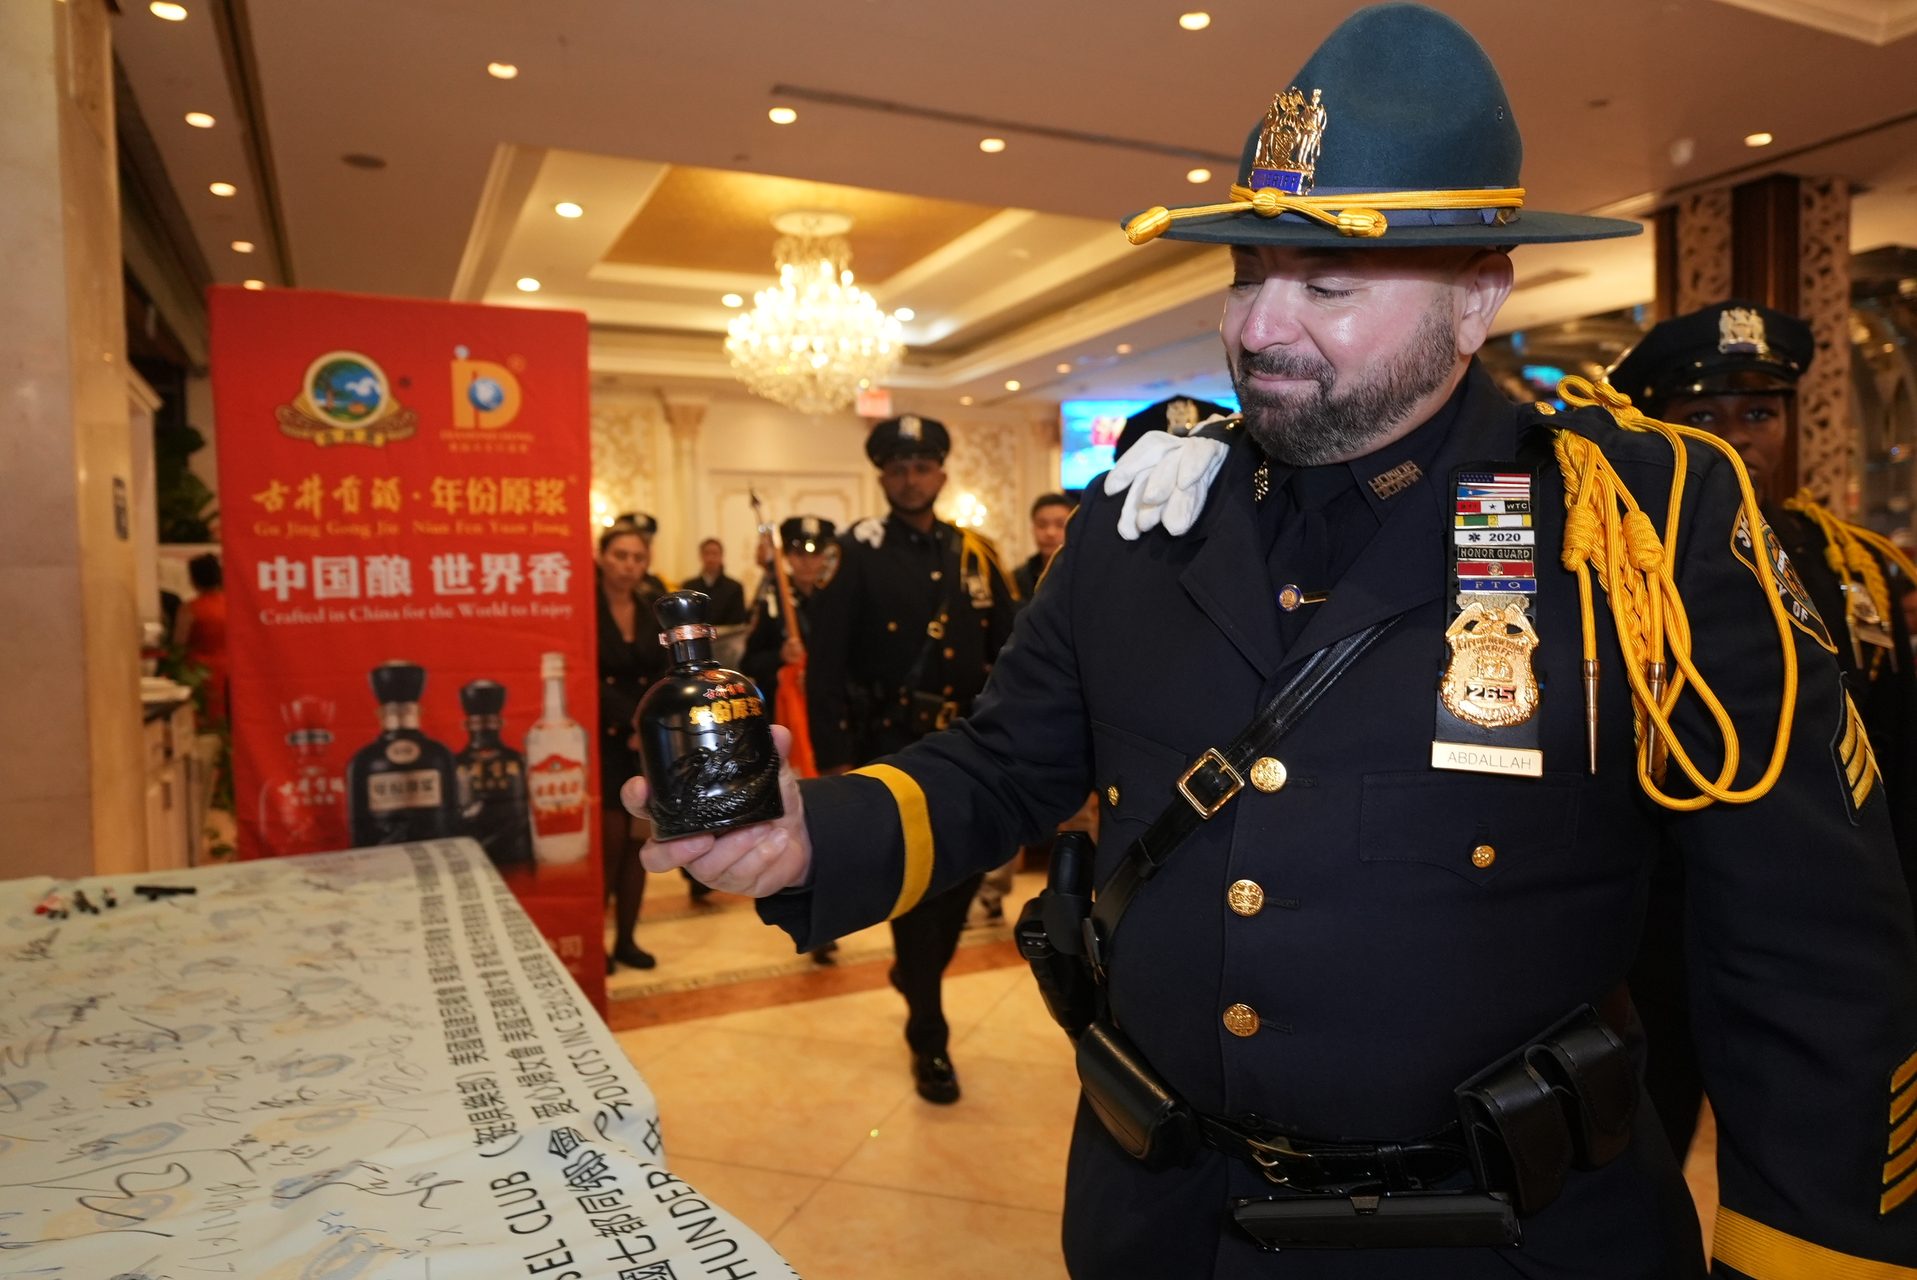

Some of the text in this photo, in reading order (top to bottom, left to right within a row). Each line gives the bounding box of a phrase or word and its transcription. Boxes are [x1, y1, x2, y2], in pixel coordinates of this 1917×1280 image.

[1506, 502, 1528, 510] WTC
[1489, 533, 1521, 542] 2020
[1460, 548, 1531, 559] HONOR GUARD
[257, 551, 572, 601] 中国酿 世界香
[259, 608, 325, 625] Crafted
[349, 605, 399, 622] China
[457, 601, 508, 617] World
[1792, 600, 1808, 623] OF
[1469, 684, 1514, 701] 265
[1448, 751, 1531, 769] ABDALLAH
[554, 1022, 593, 1048] INC
[490, 1169, 553, 1235] CLUB
[639, 1162, 758, 1280] HUNDER
